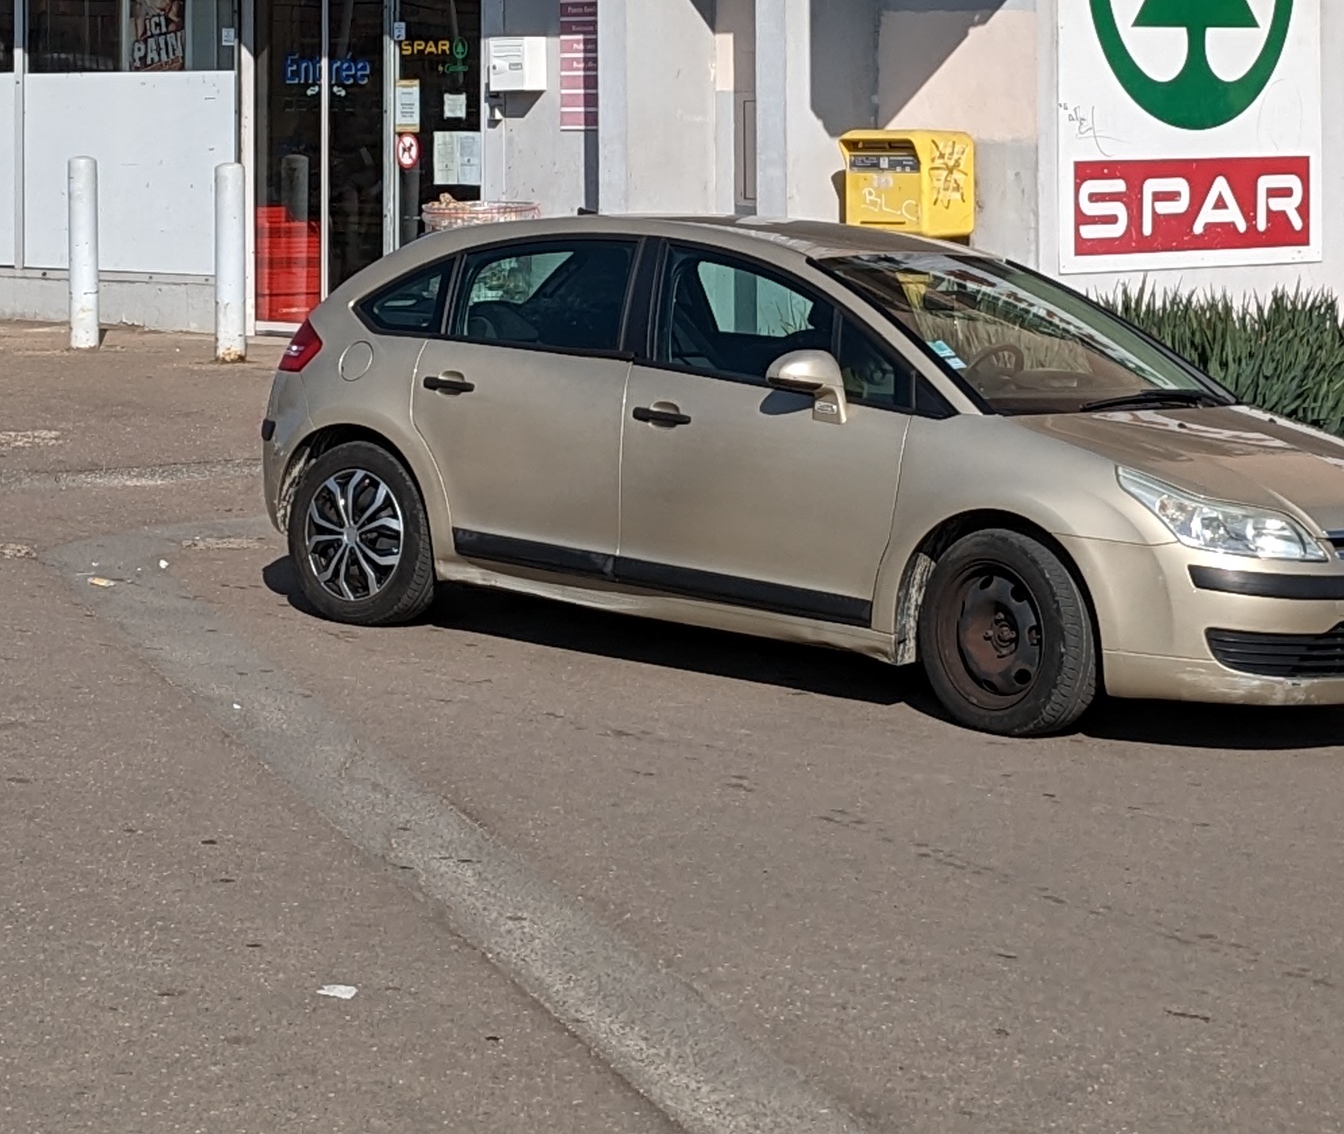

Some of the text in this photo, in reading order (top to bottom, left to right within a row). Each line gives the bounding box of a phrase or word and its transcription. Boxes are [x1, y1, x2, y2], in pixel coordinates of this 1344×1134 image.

[145, 15, 167, 36] ICI
[132, 31, 183, 68] PAIN
[401, 40, 450, 55] SPAR
[285, 52, 371, 84] Entrée
[1078, 174, 1304, 240] SPAR
